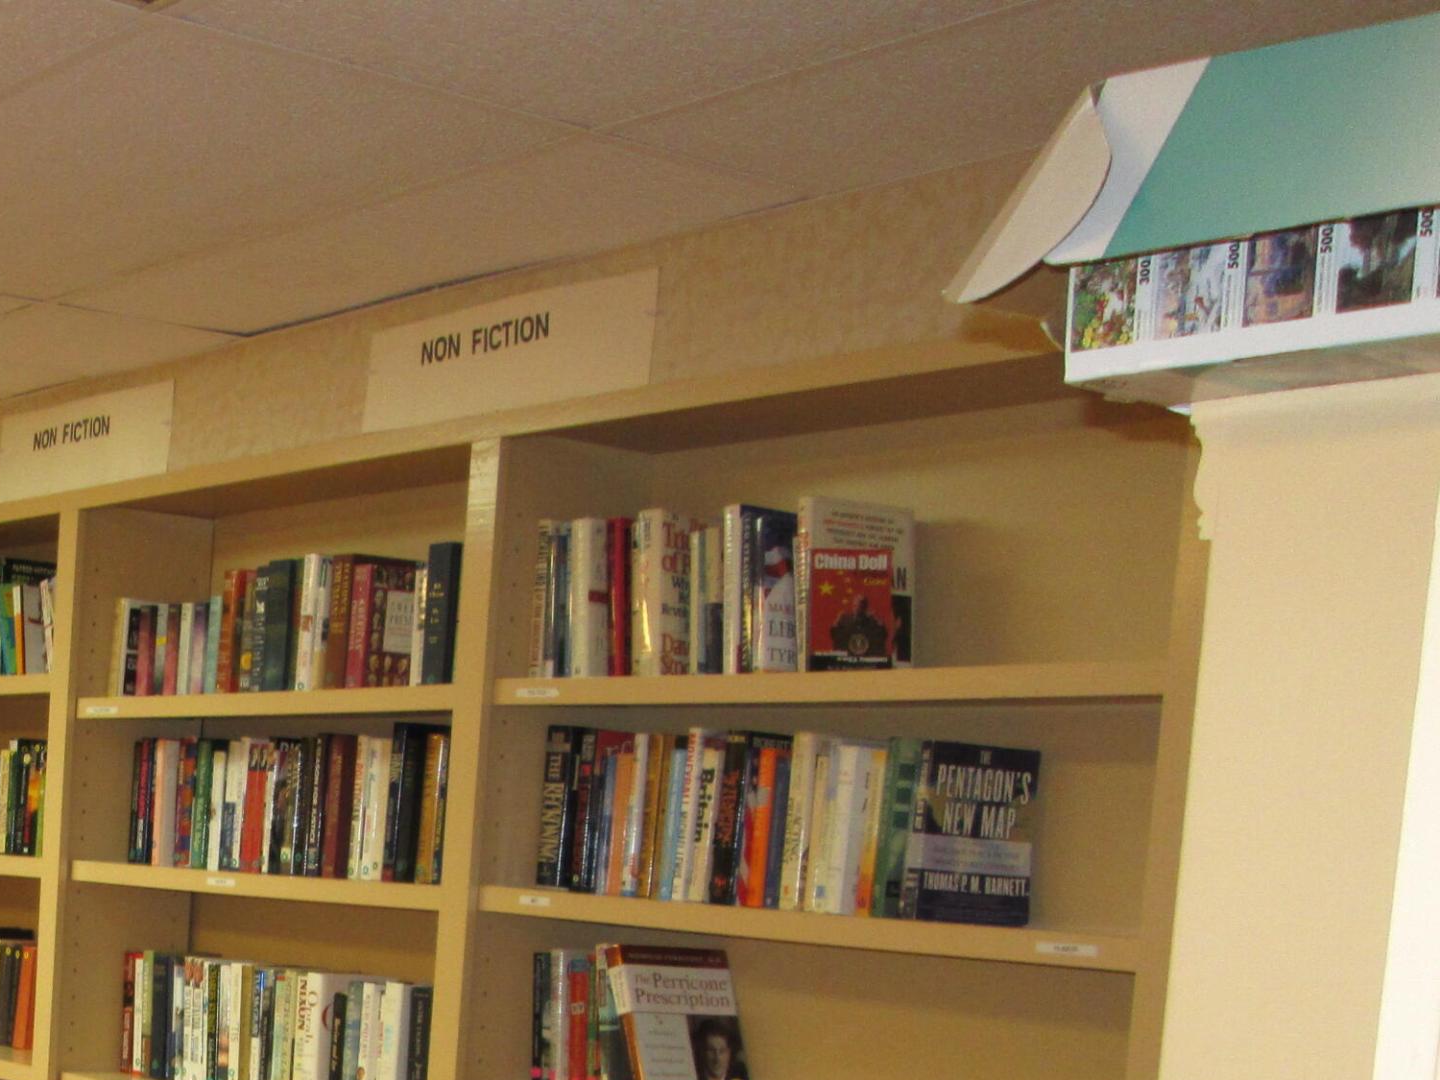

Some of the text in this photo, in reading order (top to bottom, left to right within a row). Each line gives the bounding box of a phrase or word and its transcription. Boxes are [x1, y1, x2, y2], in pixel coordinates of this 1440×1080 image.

[1320, 224, 1334, 253] 500
[1139, 259, 1151, 285] 300
[422, 312, 549, 364] NON FICTION
[34, 416, 110, 450] NON FICTION
[814, 553, 888, 571] China Doll
[680, 733, 697, 804] MONEYBALL
[936, 764, 1032, 805] PENTAGON'S
[539, 754, 565, 863] THE RECKONING
[694, 768, 716, 844] Britain
[942, 801, 1016, 839] NEW MAP
[924, 871, 960, 892] THOMAS
[635, 972, 728, 992] The Perricone
[635, 988, 731, 1009] Prescription
[298, 979, 309, 1031] NIXON
